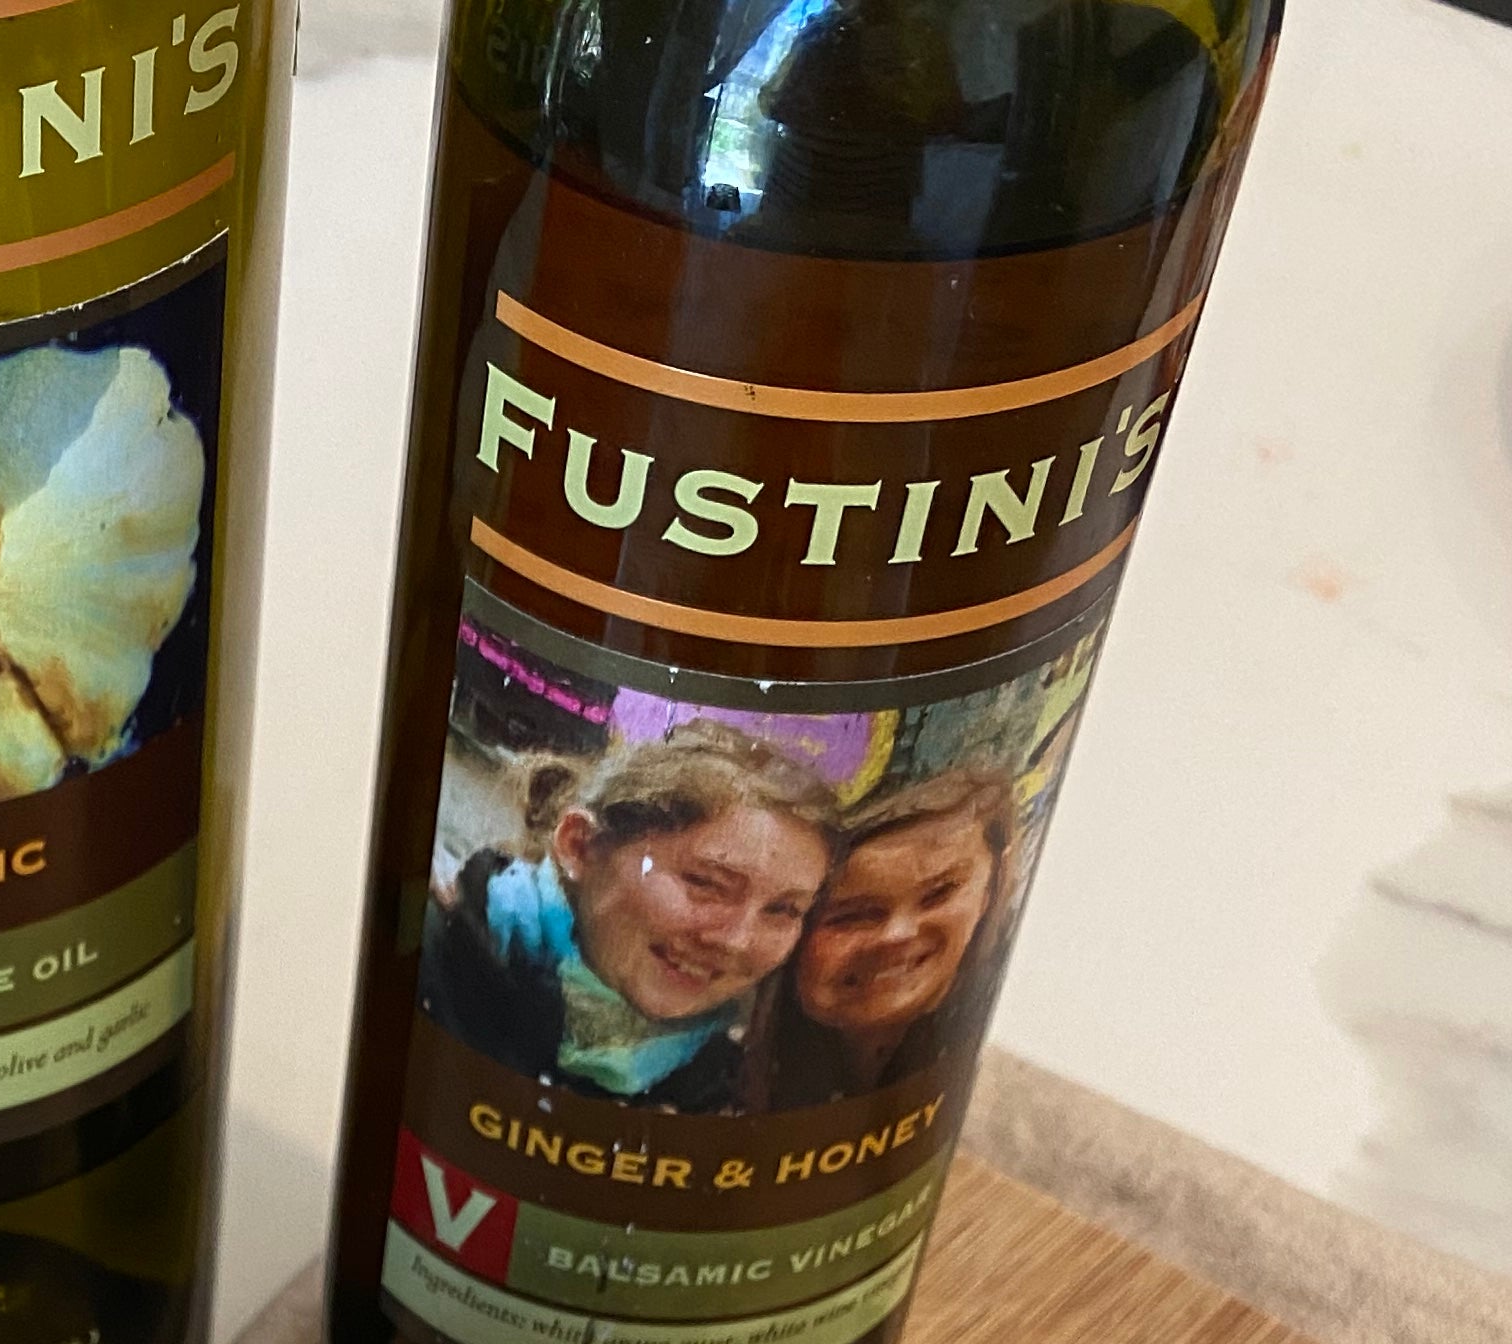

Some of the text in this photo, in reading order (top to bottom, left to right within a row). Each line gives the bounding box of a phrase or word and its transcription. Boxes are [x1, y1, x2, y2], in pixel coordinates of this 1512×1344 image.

[476, 361, 1170, 565] FUSTINI'S
[33, 943, 99, 980] OIL
[53, 1031, 91, 1064] and
[96, 1001, 152, 1054] garlic
[470, 1094, 944, 1189] GINGER & HONEY
[420, 1155, 497, 1252] V
[548, 1183, 931, 1286] BALSAMIC VINEGAR
[411, 1255, 527, 1329] Ingredients:
